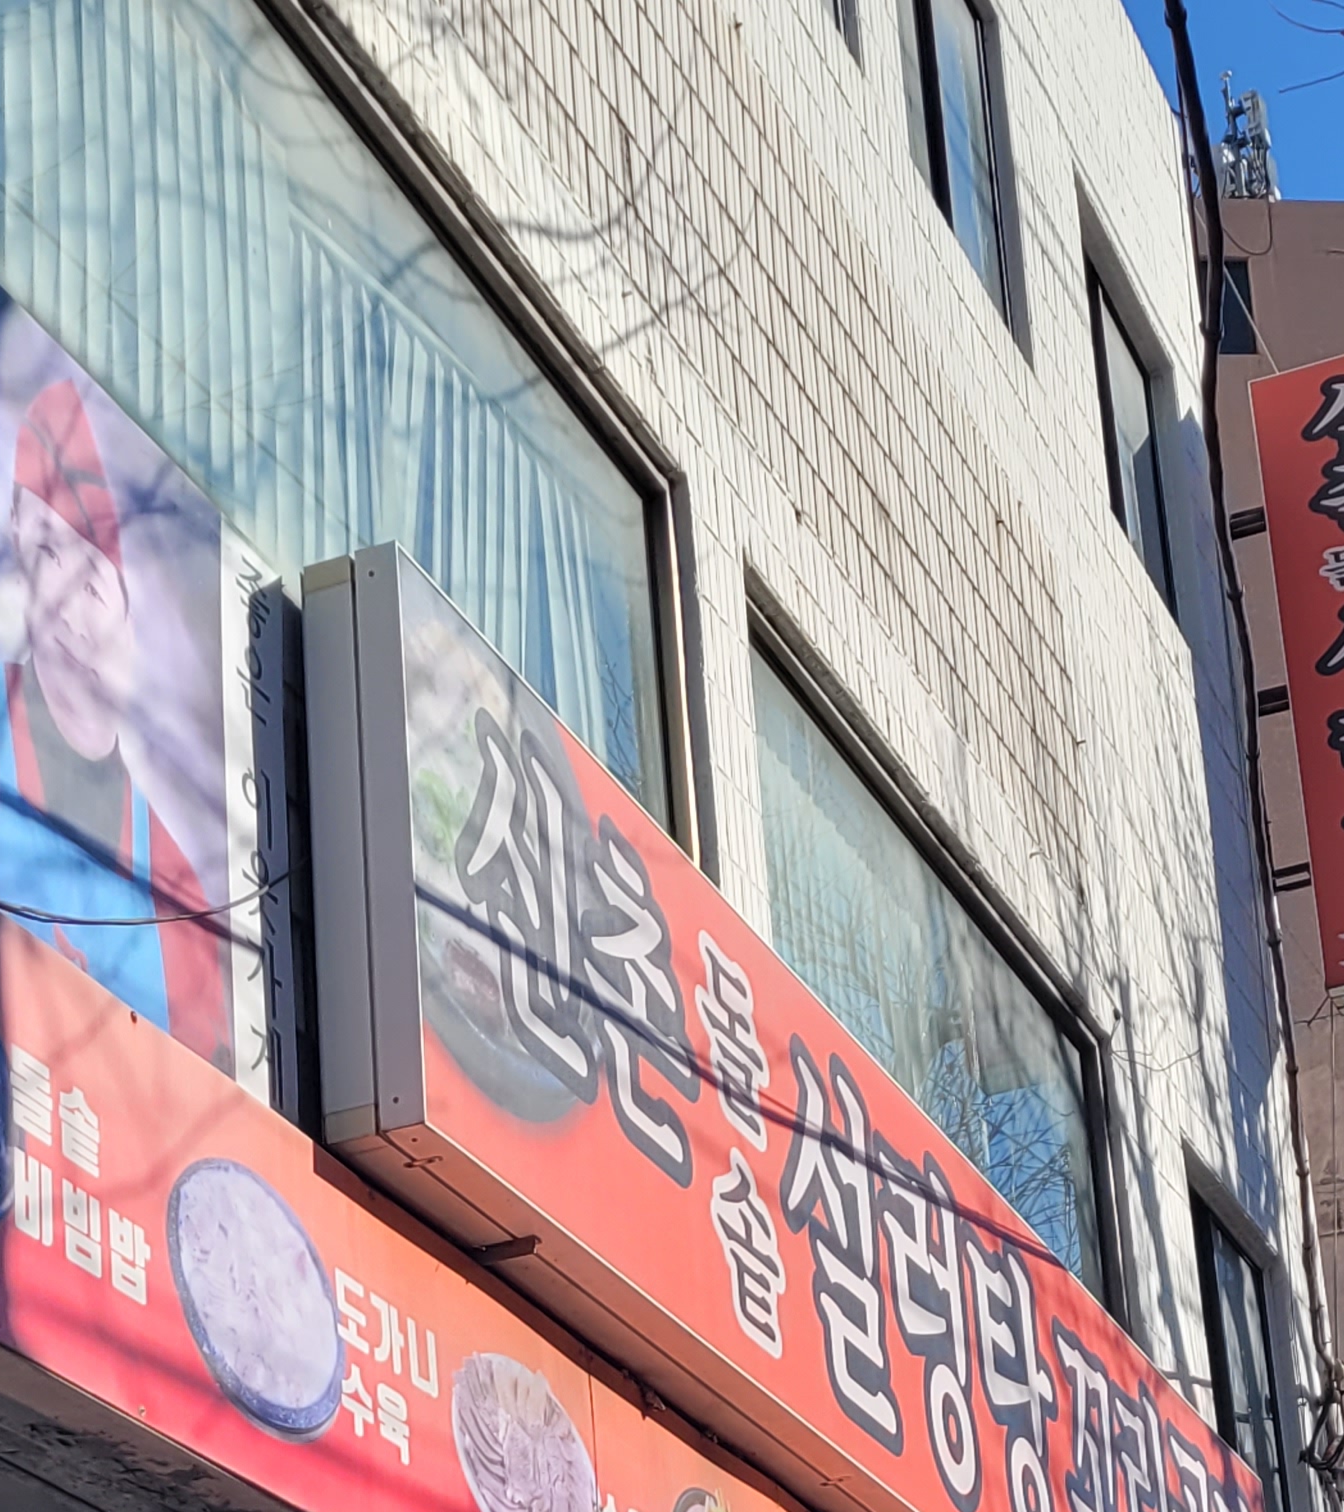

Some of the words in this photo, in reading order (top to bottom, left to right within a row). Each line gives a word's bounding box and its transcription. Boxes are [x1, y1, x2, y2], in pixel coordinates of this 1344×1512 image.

[459, 709, 698, 1185] 신촌
[696, 931, 786, 1358] 돌솥
[11, 1044, 101, 1178] 돌솥
[12, 1146, 152, 1306] 비빔밥
[336, 1267, 440, 1400] 도가니
[342, 1371, 411, 1465] 수육
